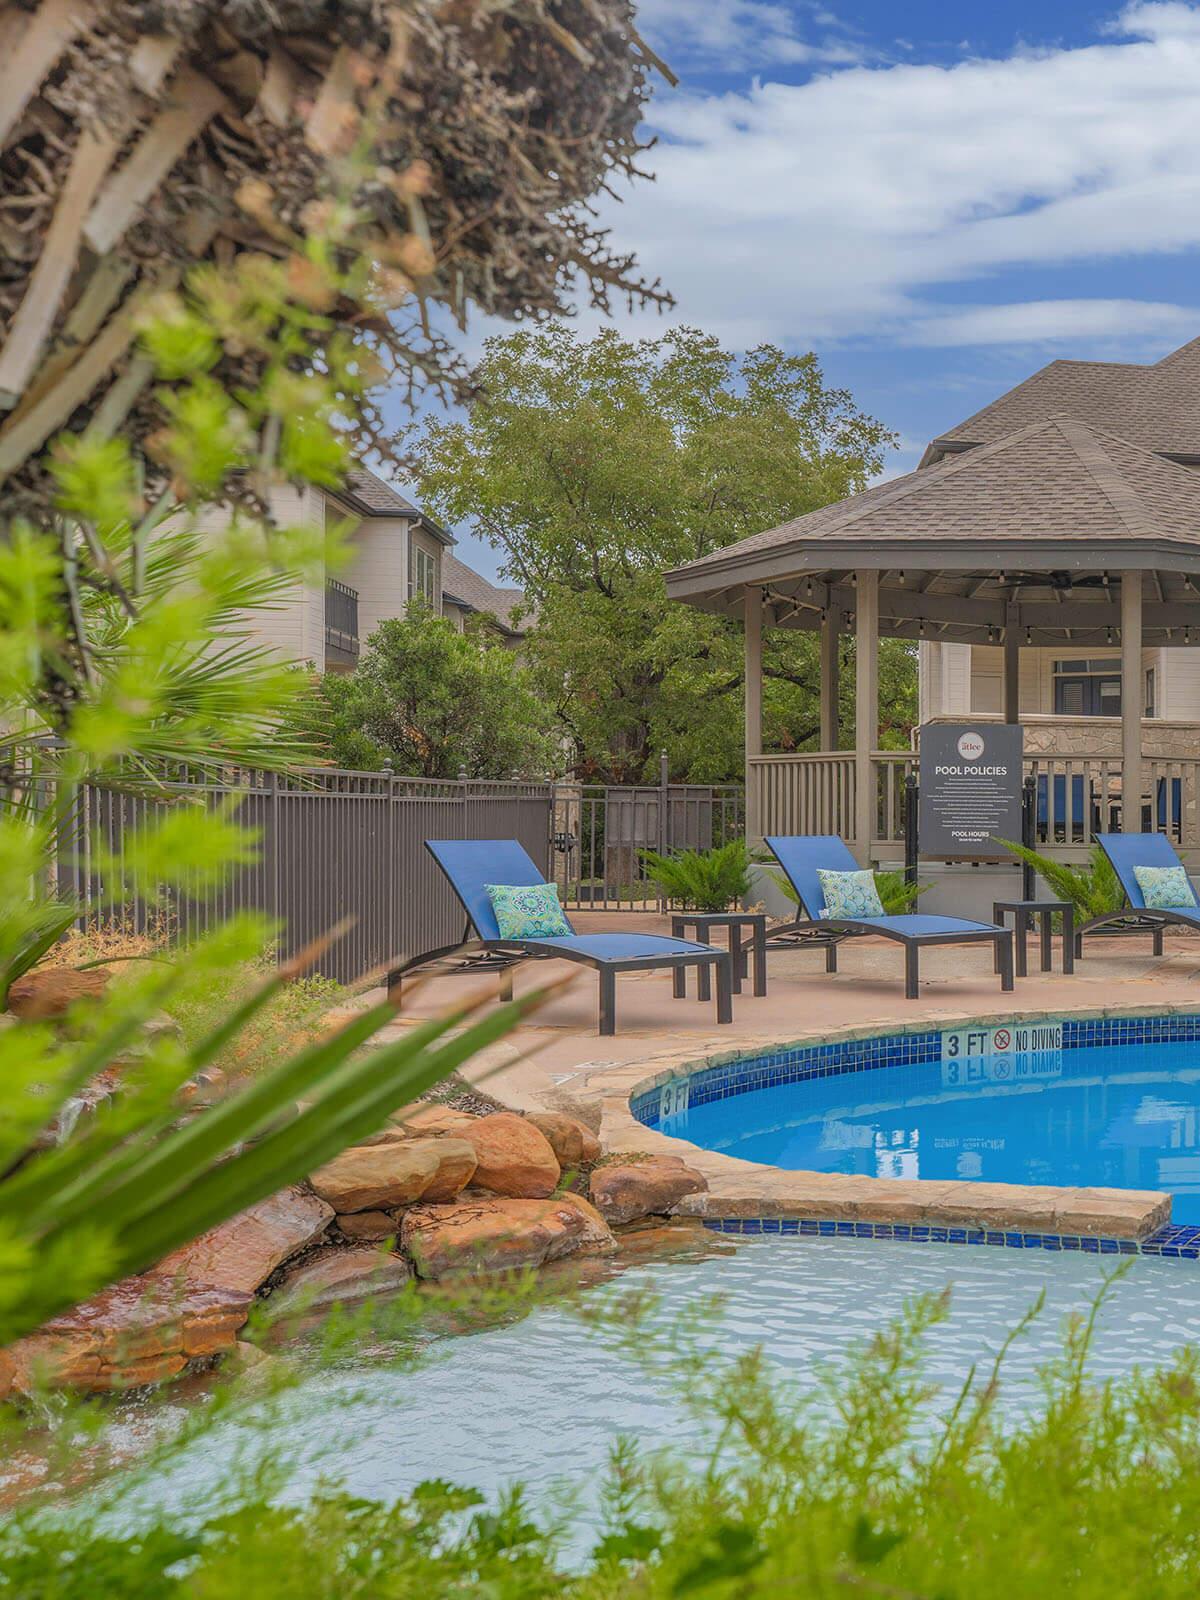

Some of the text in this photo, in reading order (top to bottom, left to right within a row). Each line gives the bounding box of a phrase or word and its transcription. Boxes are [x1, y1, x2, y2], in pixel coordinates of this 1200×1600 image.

[935, 766, 1008, 775] POOL POLICIES
[948, 1028, 1061, 1057] 3 FT NO DIVING
[664, 1082, 689, 1115] 3 FT
